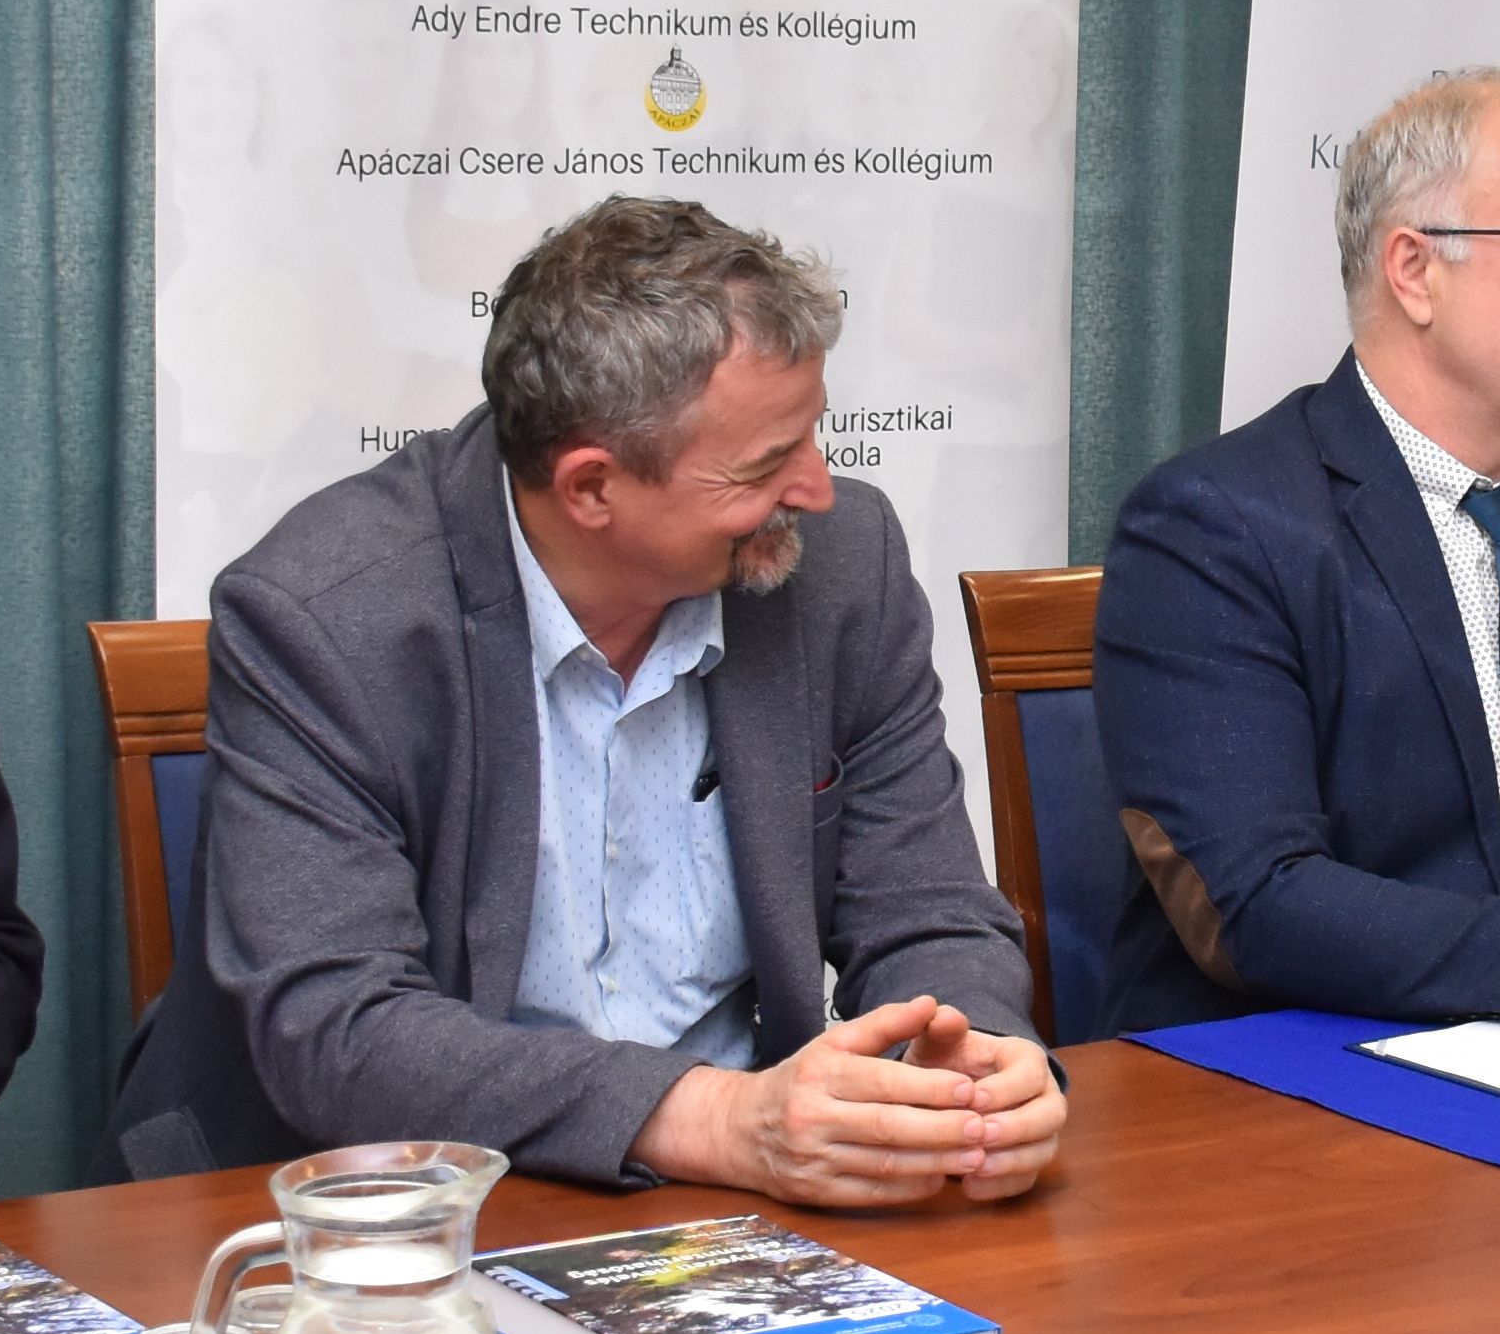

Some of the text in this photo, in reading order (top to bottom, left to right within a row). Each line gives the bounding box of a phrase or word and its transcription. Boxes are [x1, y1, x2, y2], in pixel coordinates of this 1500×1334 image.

[411, 4, 916, 46] Ady Endre Technikum és Kollégium
[336, 146, 993, 182] Apáczai Csere János Technikum és Kollégium
[825, 441, 881, 468] kola
